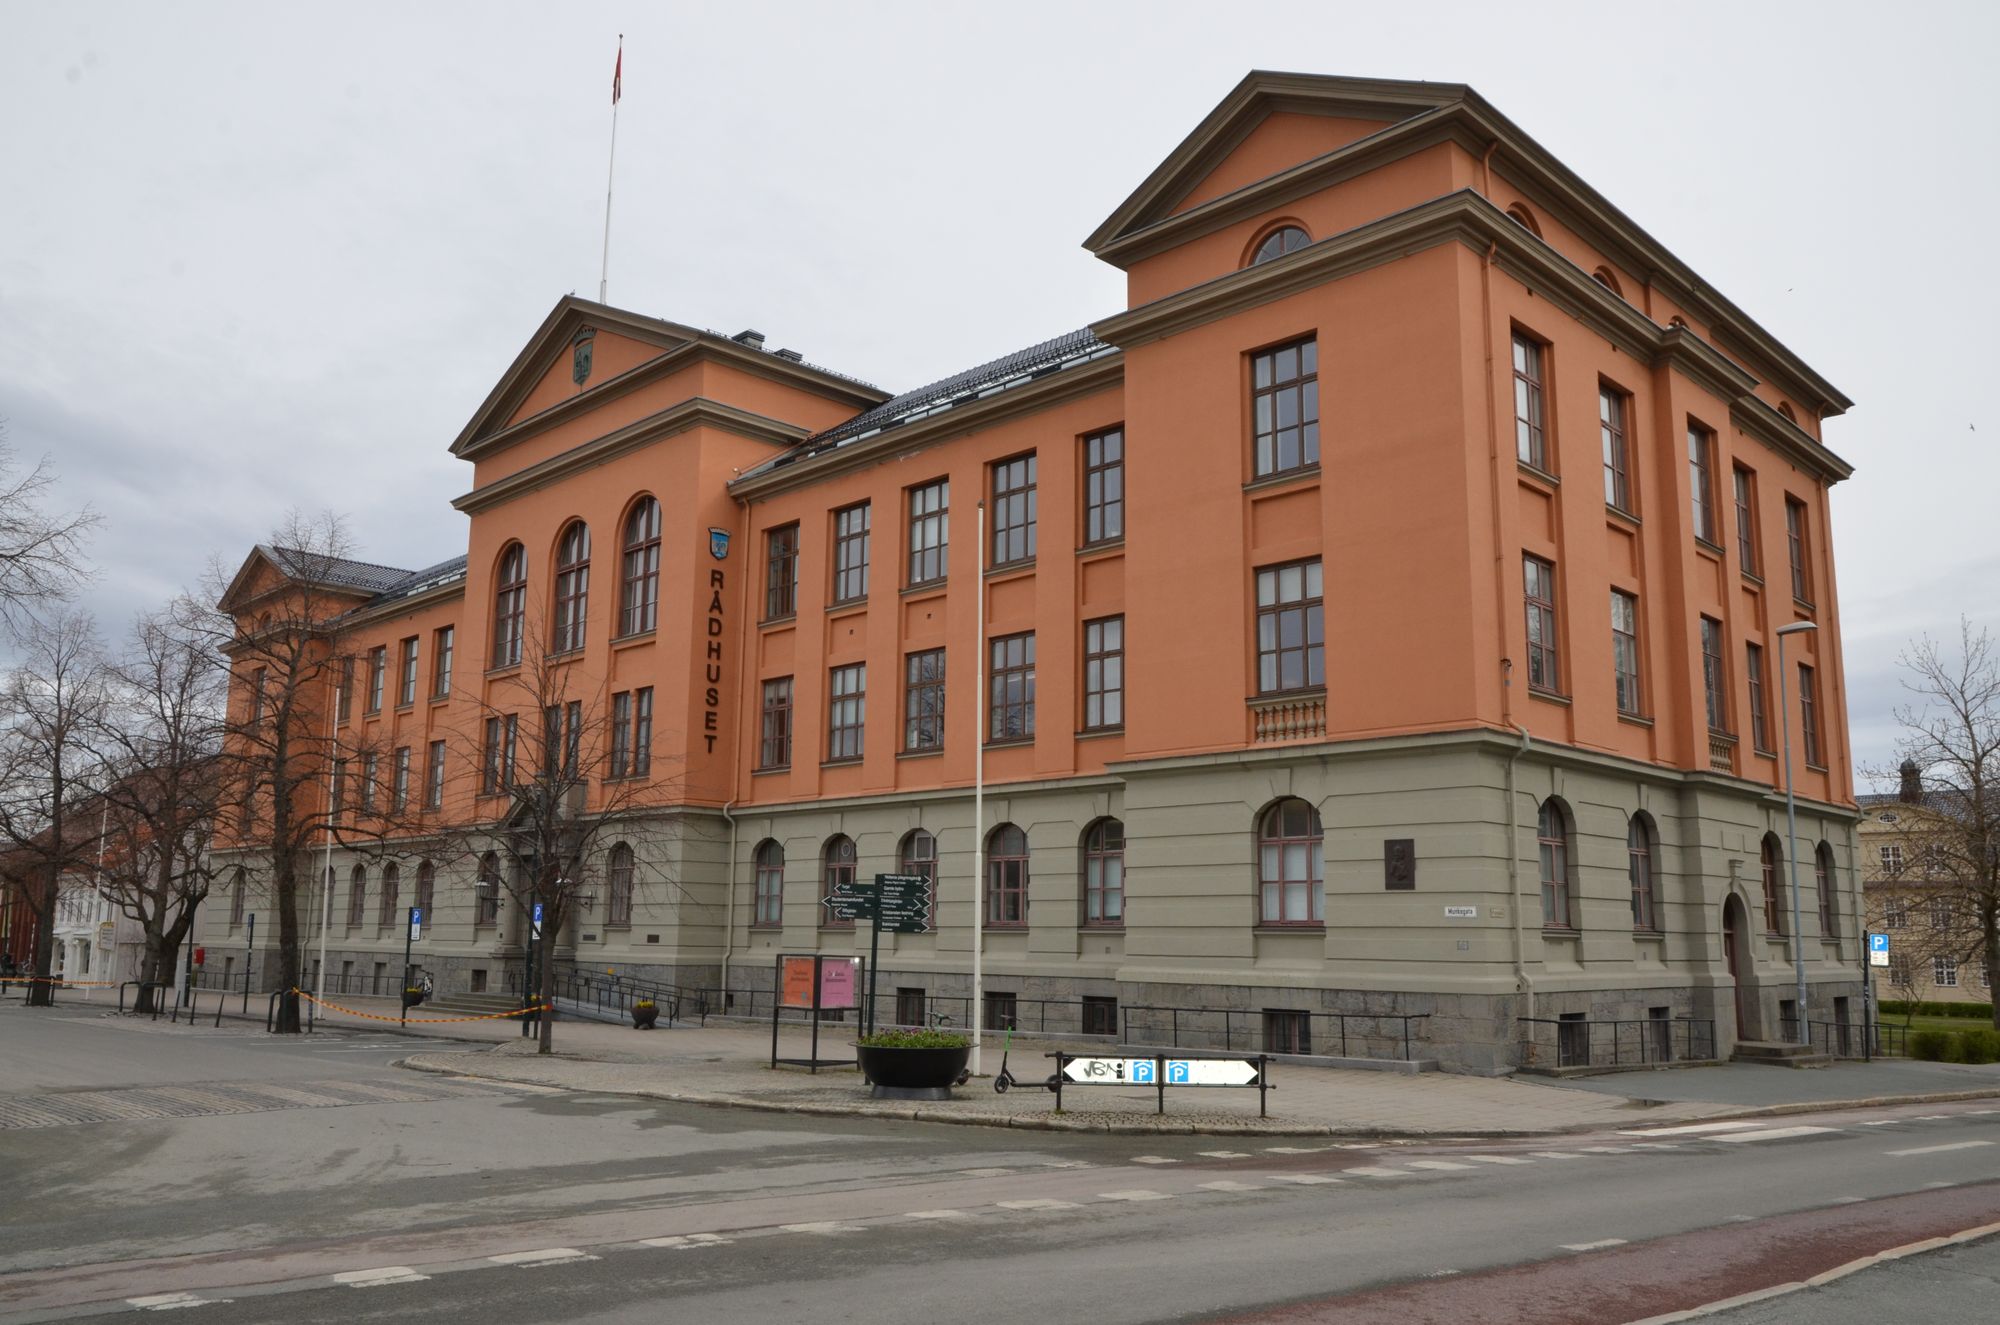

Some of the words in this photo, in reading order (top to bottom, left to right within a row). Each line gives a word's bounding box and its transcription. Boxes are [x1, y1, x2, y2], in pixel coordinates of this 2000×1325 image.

[704, 569, 724, 754] RÅDHUSET
[413, 911, 419, 922] P
[535, 906, 541, 920] P
[1874, 937, 1884, 950] P
[1138, 1067, 1149, 1081] P
[1174, 1067, 1184, 1081] P
